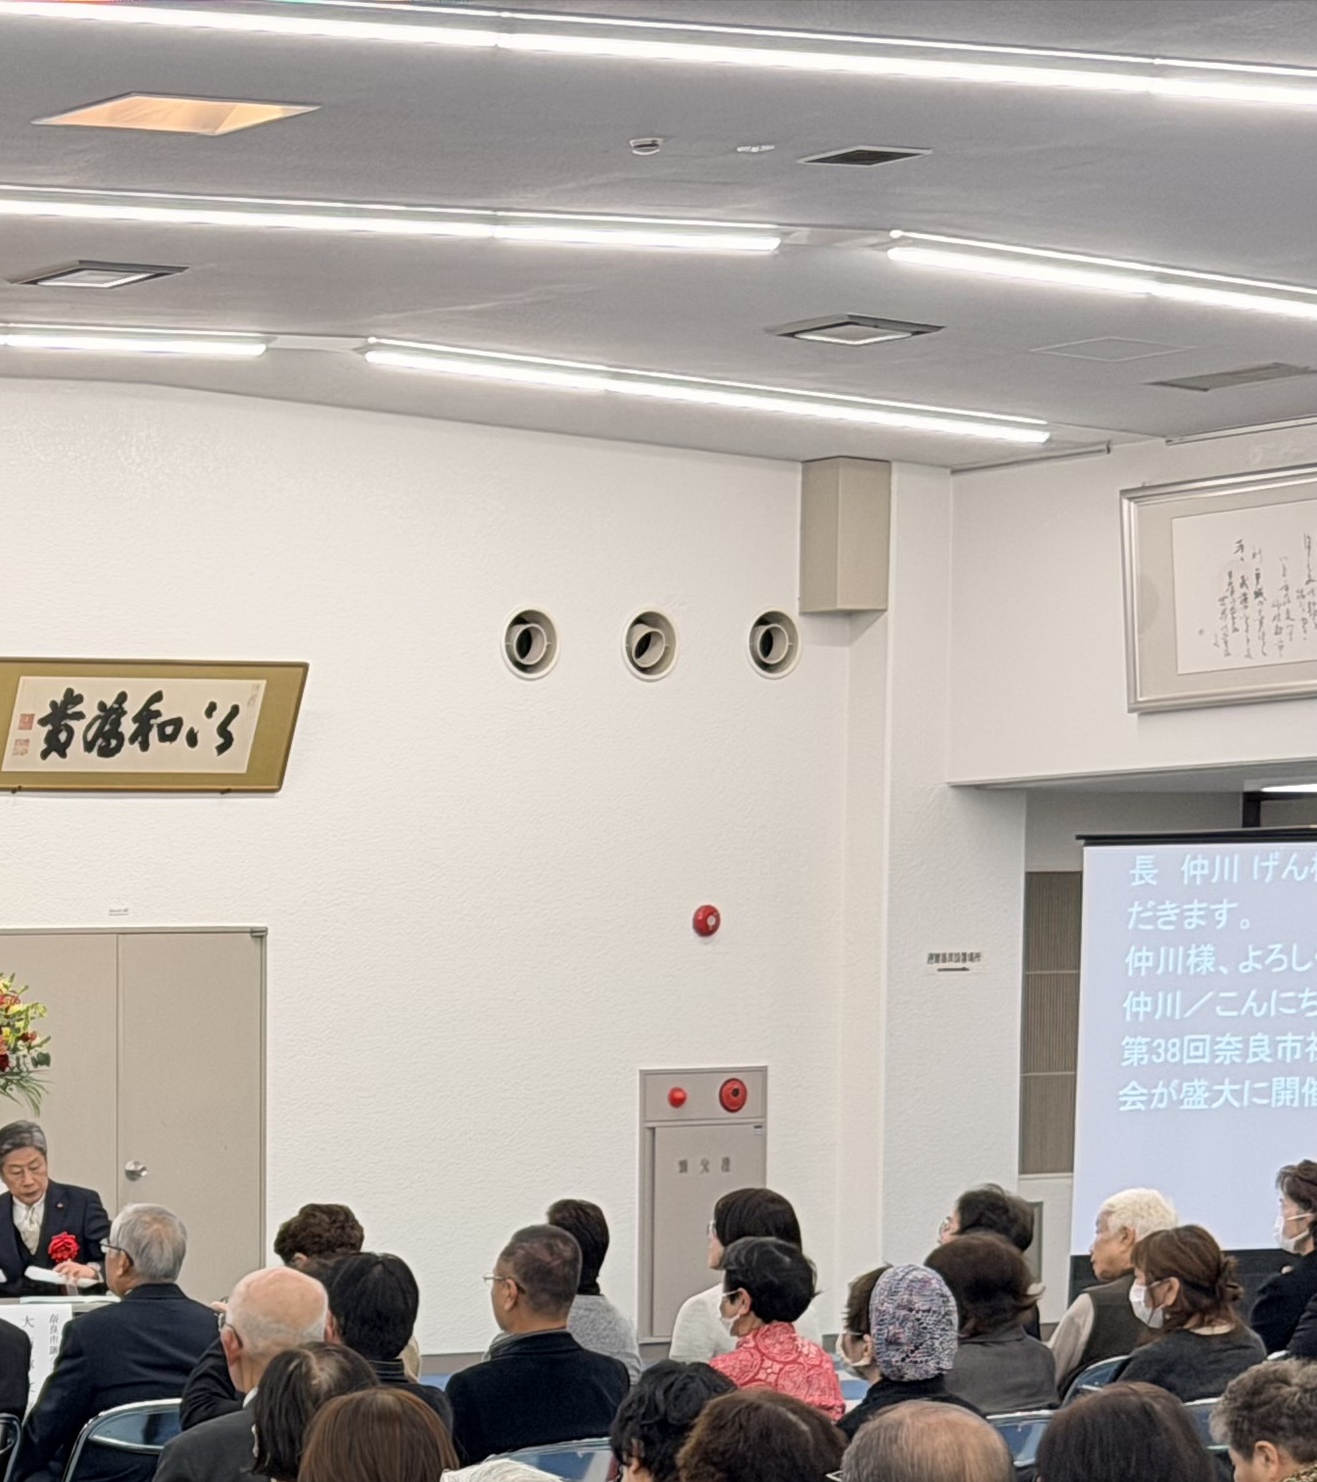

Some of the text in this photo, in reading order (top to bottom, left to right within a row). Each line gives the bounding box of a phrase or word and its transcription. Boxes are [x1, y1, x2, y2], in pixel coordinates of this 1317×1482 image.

[1129, 854, 1159, 887] 長
[1180, 853, 1239, 886] 仲川
[1127, 898, 1251, 931] だきます。
[1124, 943, 1317, 977] 仲川様、よろし
